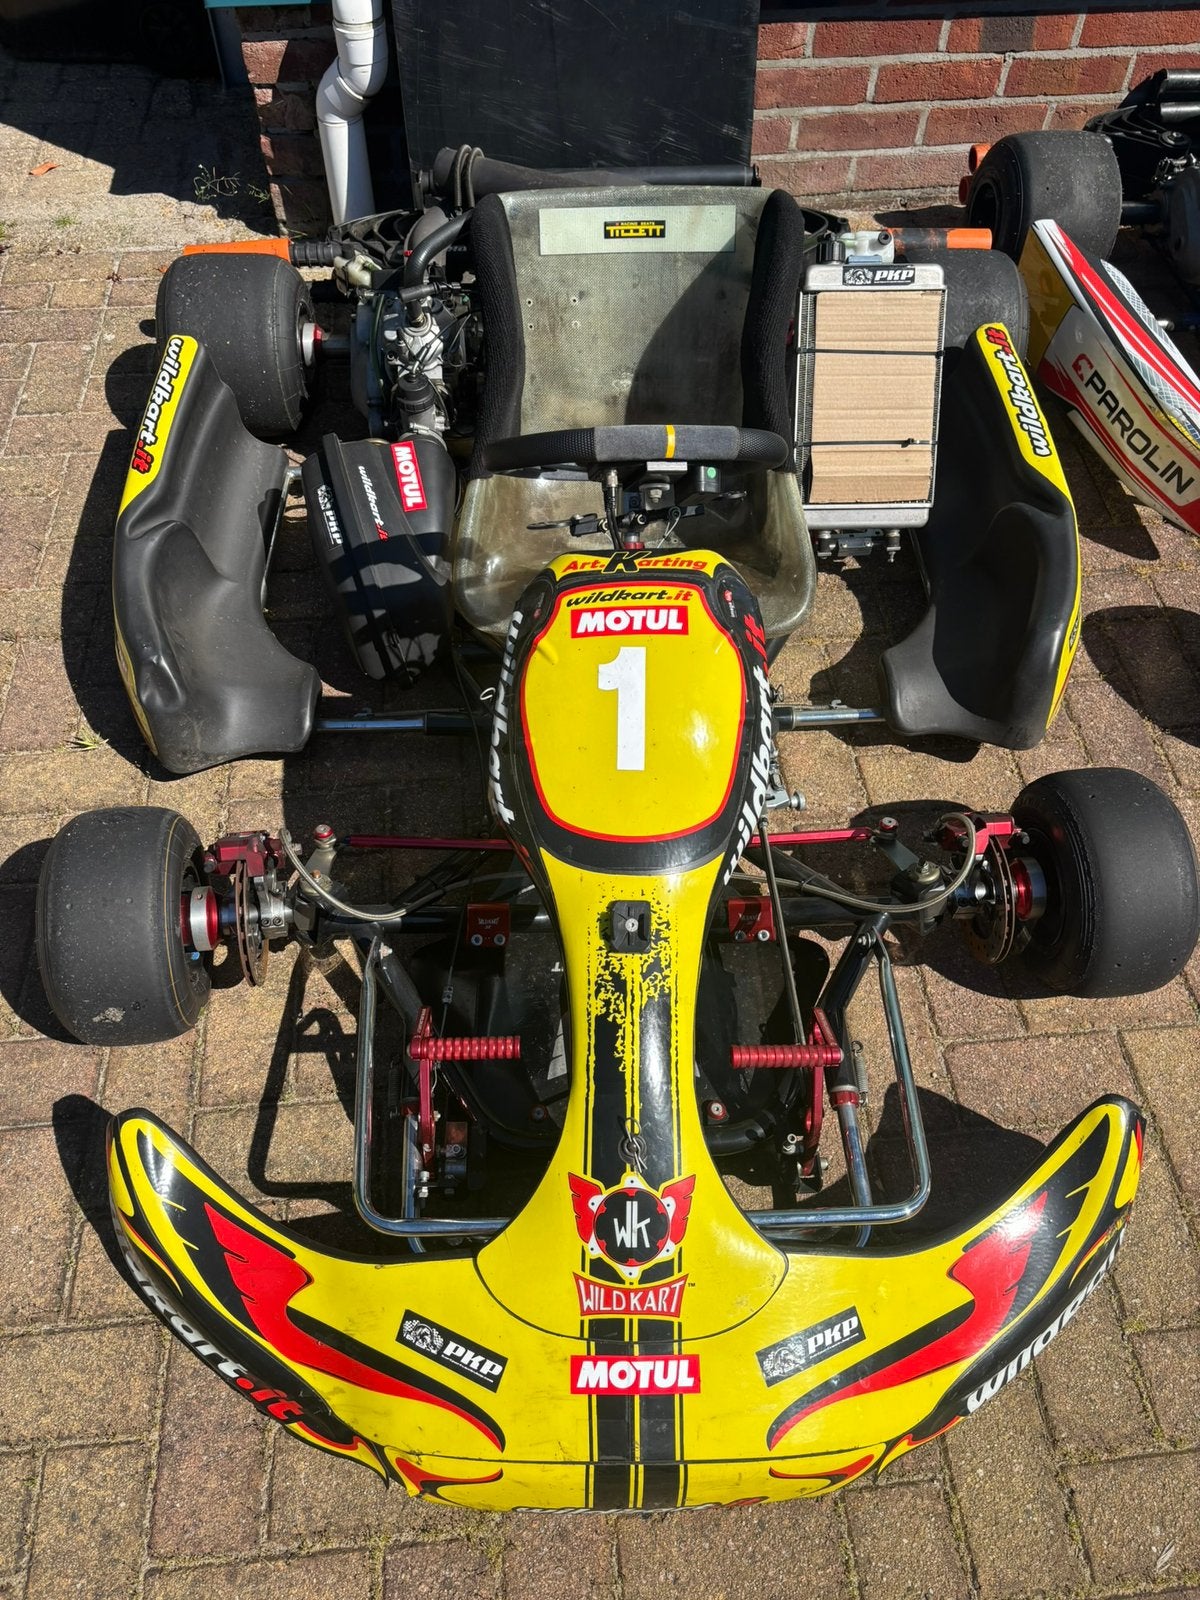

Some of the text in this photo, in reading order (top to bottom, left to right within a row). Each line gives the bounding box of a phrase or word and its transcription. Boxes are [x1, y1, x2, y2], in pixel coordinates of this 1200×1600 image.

[606, 224, 665, 237] TILLETT
[874, 270, 914, 281] PKP
[132, 337, 184, 473] wildkart.it
[986, 328, 1052, 456] wildkart.it
[1085, 370, 1195, 495] PAROLIN
[394, 446, 423, 507] MOTUL
[358, 465, 388, 541] wildkart.it
[325, 510, 343, 544] PKP
[566, 589, 693, 607] wildkart.it
[576, 609, 683, 633] MOTUL
[598, 646, 646, 771] 1
[807, 1316, 858, 1354] PKP
[443, 1341, 503, 1376] PKP
[576, 1359, 694, 1388] MOTUL
